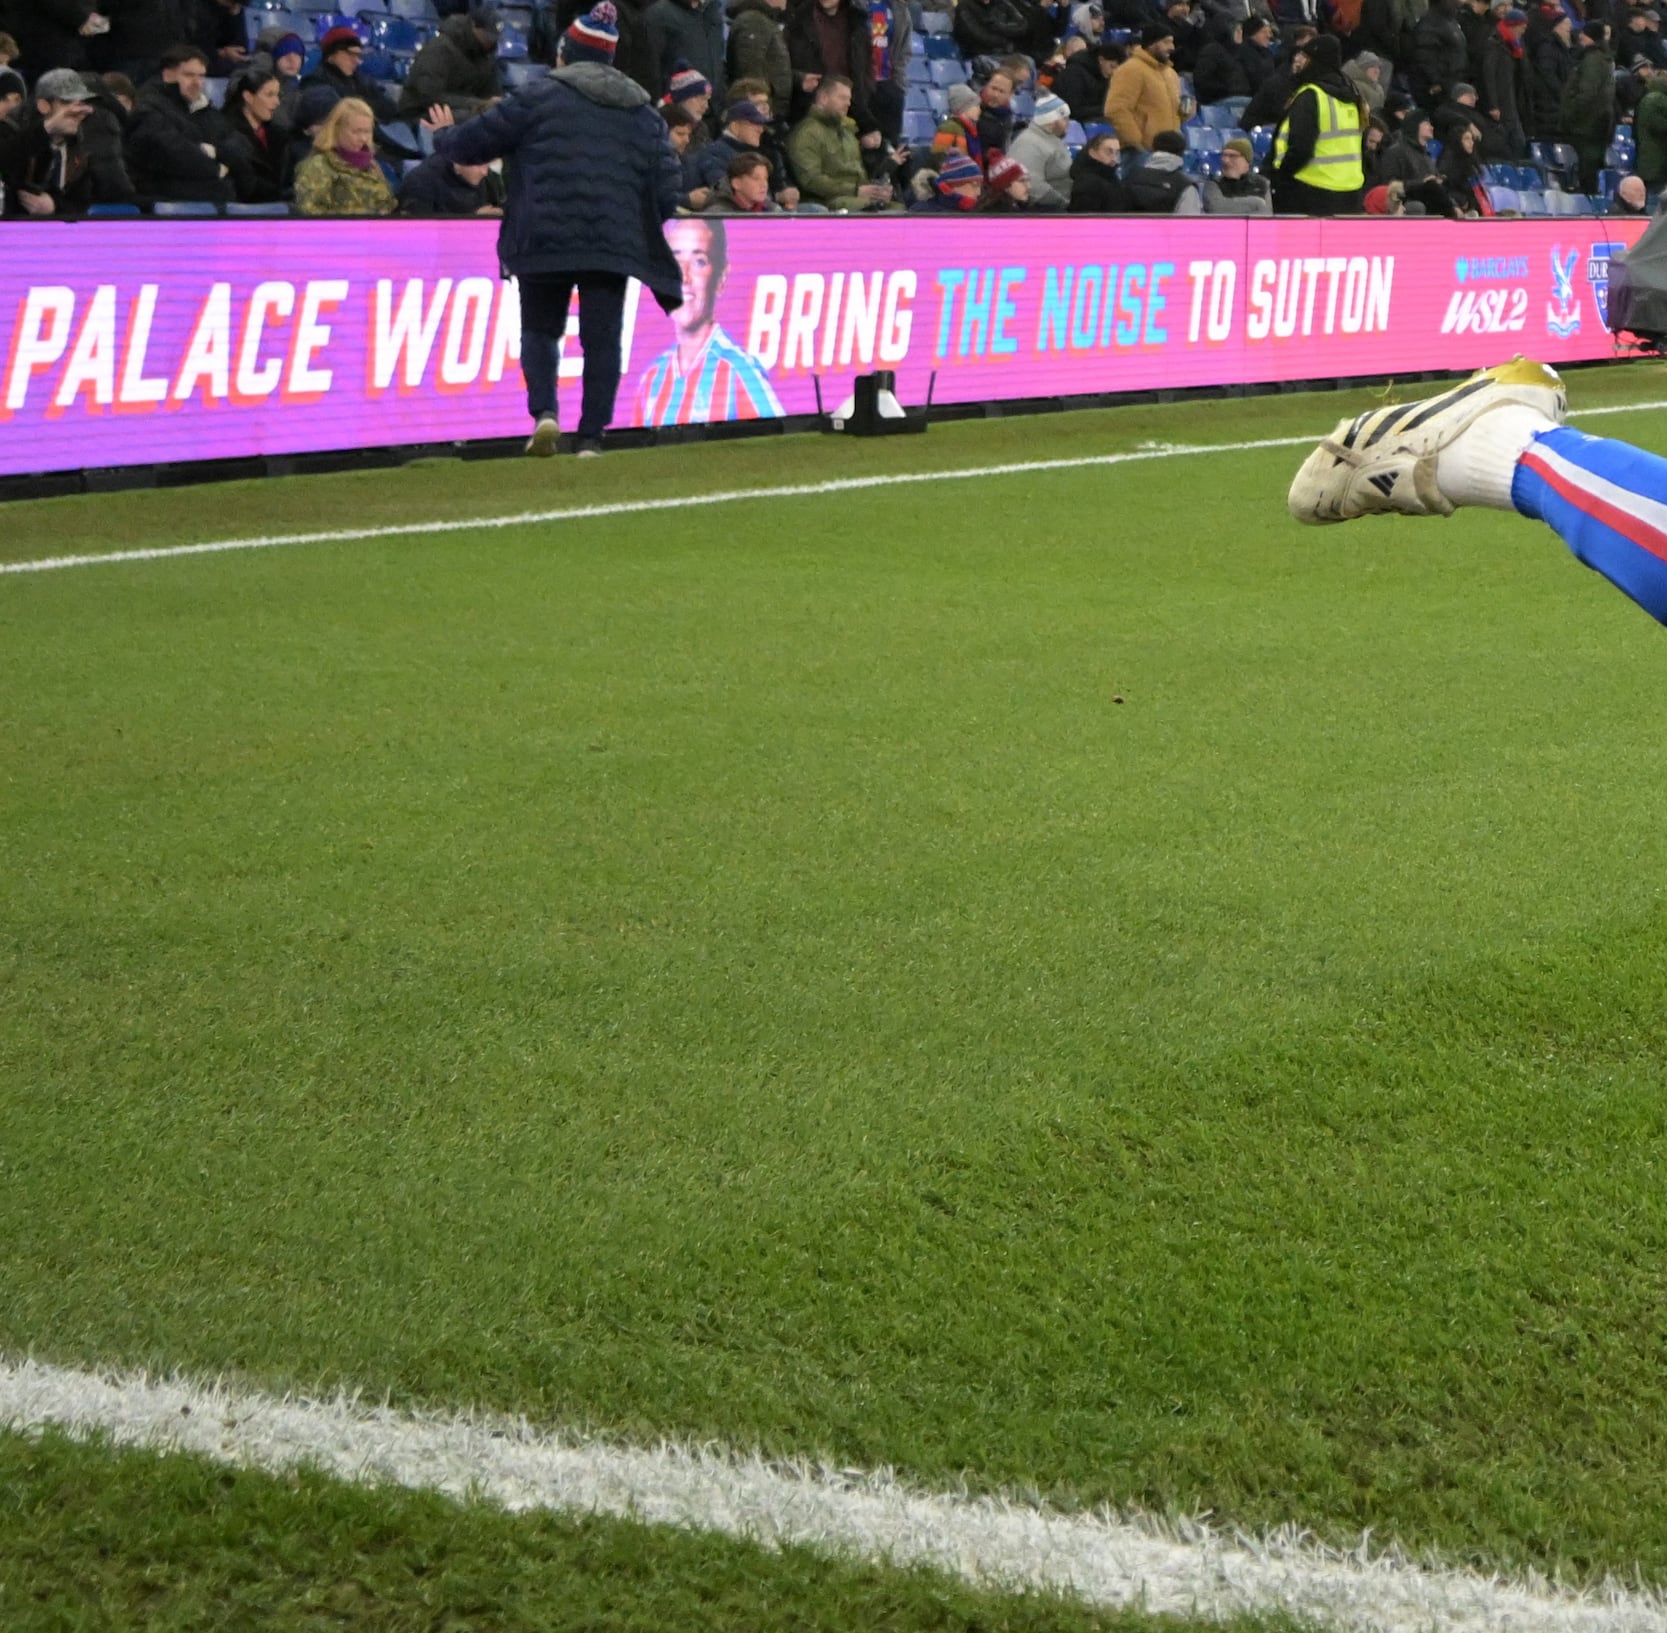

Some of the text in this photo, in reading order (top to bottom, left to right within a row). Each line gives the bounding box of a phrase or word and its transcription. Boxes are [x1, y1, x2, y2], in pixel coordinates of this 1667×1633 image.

[1470, 256, 1530, 280] BARCLAYS
[1588, 261, 1609, 280] DUR
[1440, 287, 1529, 335] WSL2
[5, 279, 349, 409] PALACE
[748, 269, 917, 370] BRING
[936, 266, 1027, 358] THE
[1037, 261, 1176, 352] NOISE
[1188, 260, 1237, 343] TO
[1247, 255, 1395, 339] SUTTON
